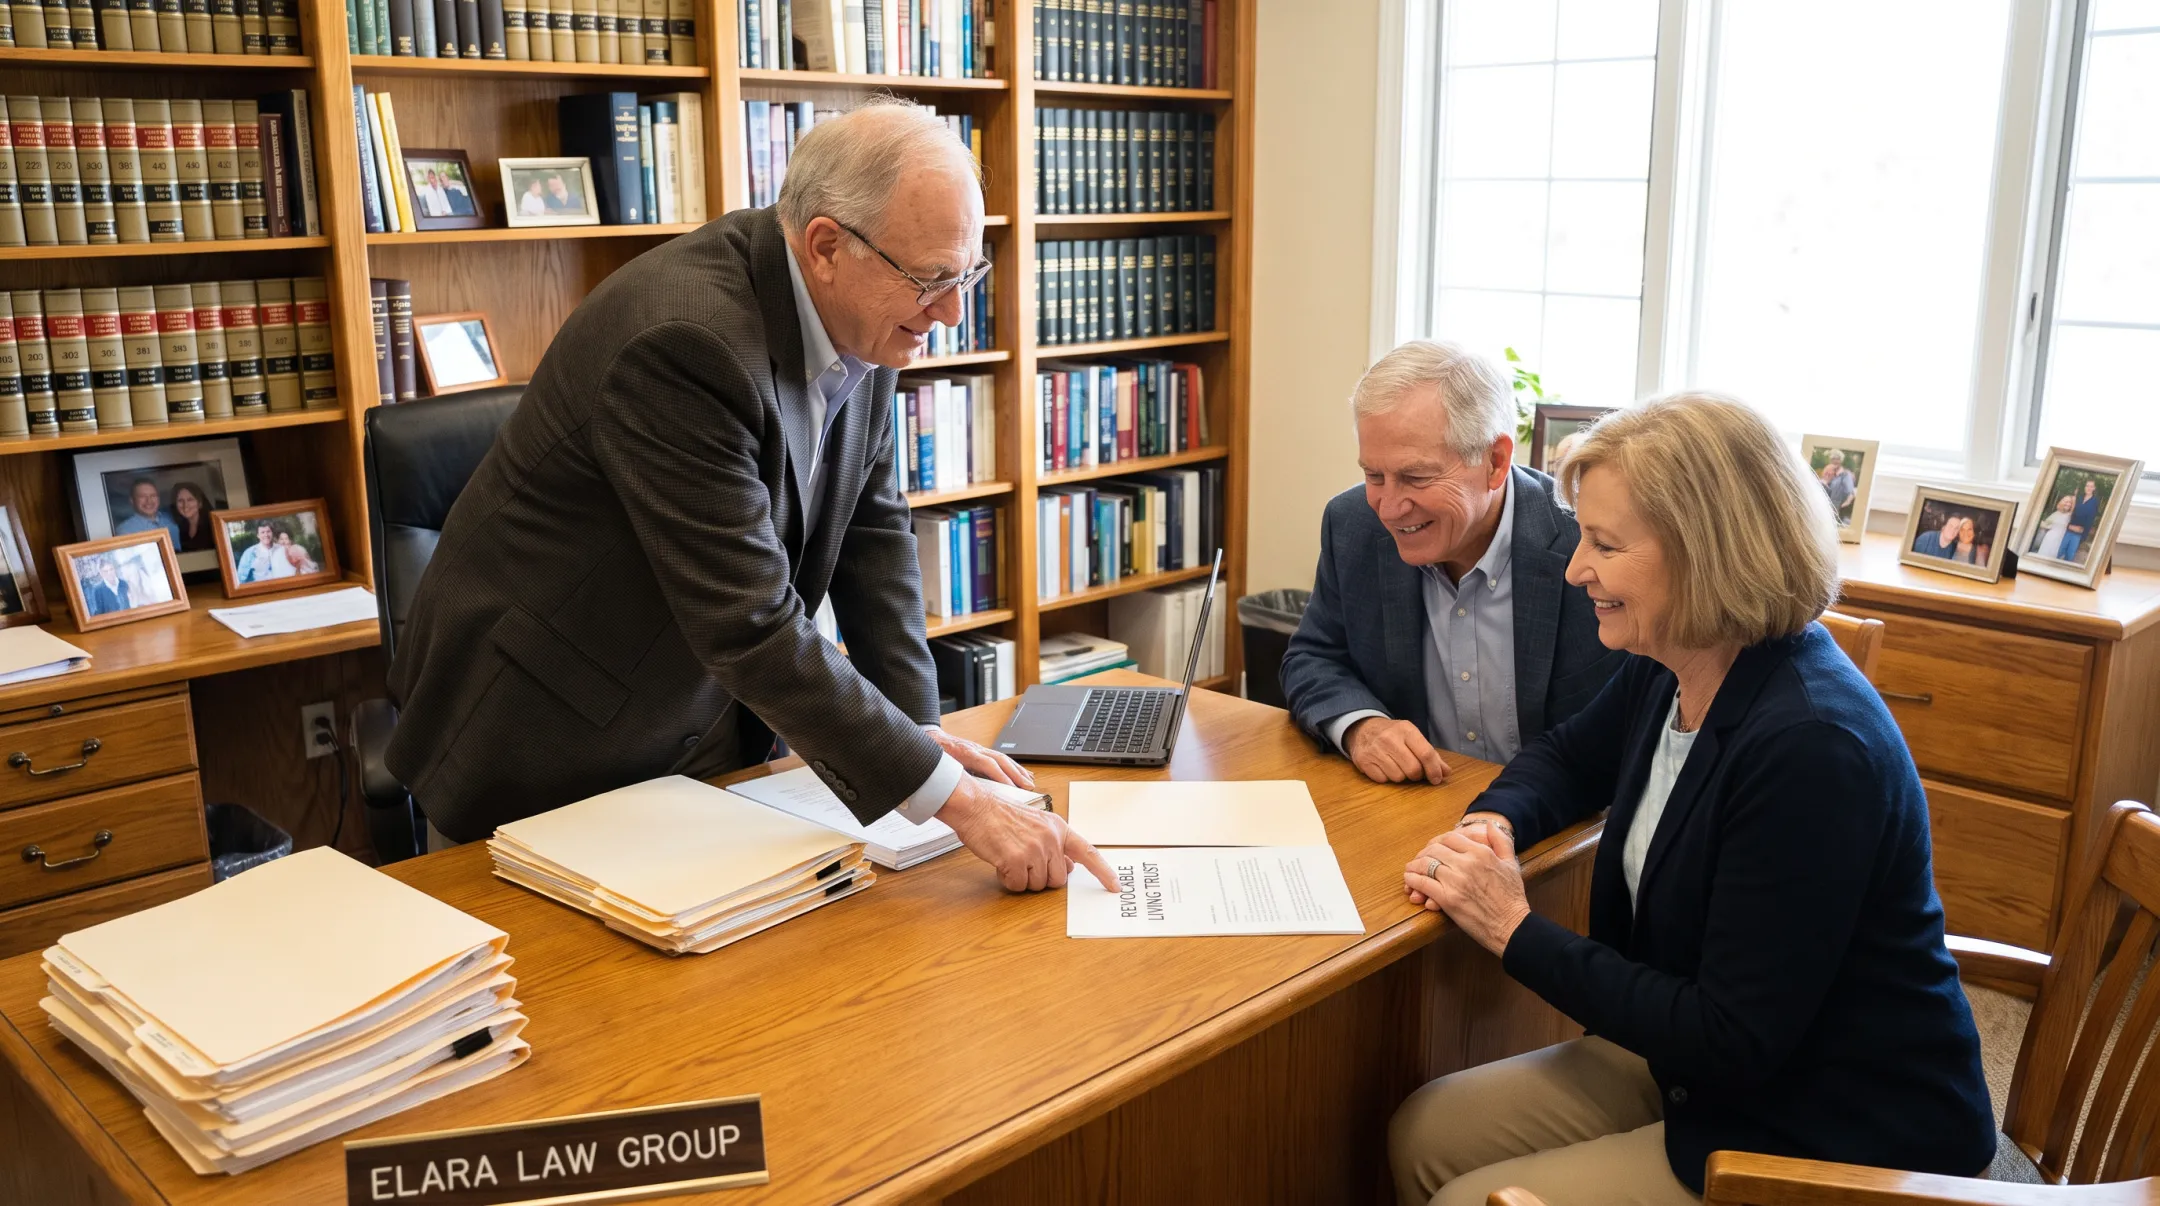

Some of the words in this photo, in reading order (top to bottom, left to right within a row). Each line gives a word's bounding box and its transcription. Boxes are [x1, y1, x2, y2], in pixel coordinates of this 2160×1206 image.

[1118, 866, 1137, 918] REVOCABLE
[1142, 862, 1161, 890] TRUST
[1146, 891, 1165, 921] LIVING
[370, 1154, 499, 1201] ELARA
[516, 1141, 599, 1183] LAW
[617, 1124, 741, 1169] GROUP
